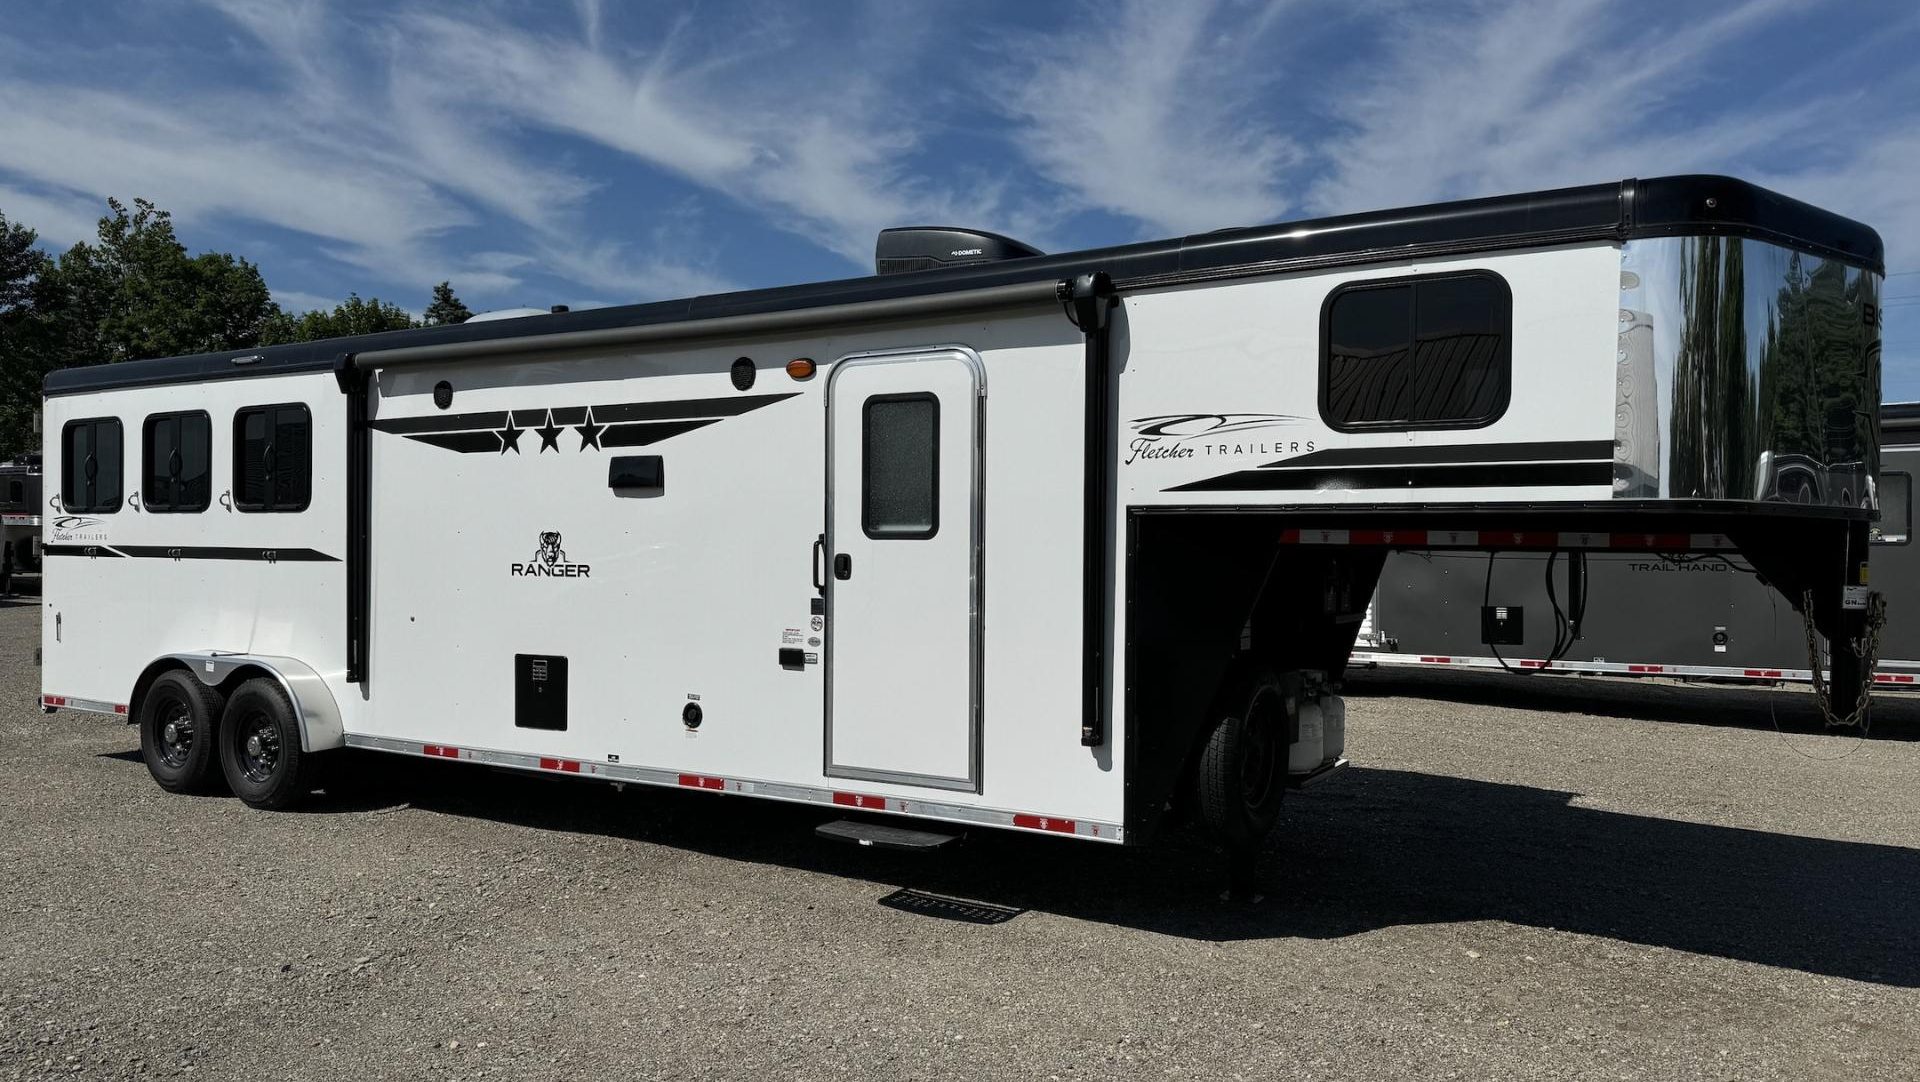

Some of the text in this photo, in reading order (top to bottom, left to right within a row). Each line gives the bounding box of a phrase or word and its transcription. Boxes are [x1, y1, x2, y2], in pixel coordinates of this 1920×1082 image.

[958, 248, 982, 256] DOMETIC
[1125, 437, 1316, 465] Fletcher TRAILERS
[75, 533, 108, 541] TRAILERS
[511, 563, 591, 578] RANGER
[1628, 563, 1728, 572] TRAIL HAND
